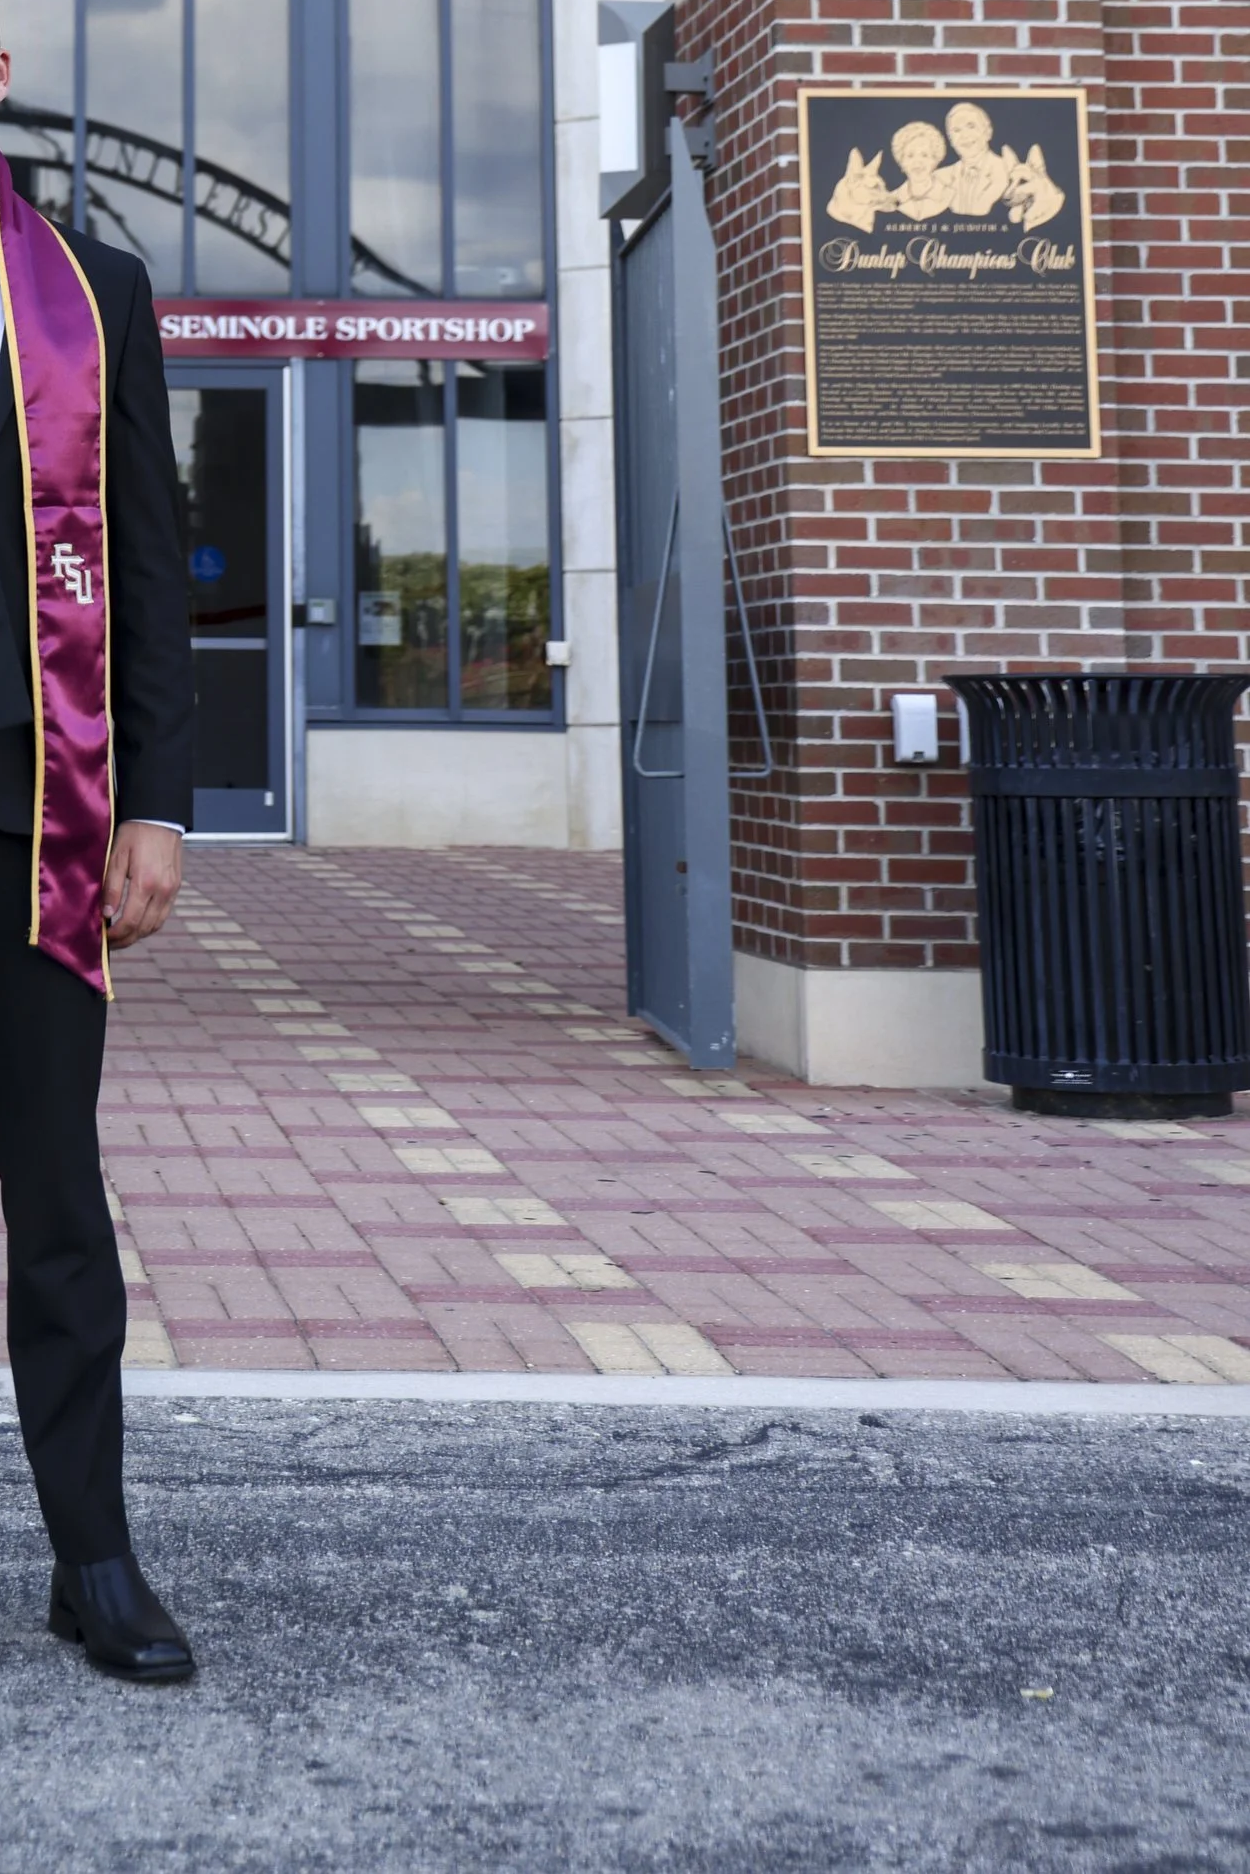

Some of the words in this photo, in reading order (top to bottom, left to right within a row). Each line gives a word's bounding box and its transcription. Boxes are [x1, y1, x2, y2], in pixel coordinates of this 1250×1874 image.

[818, 236, 907, 280] Dunlap
[905, 235, 1018, 280] Champions
[1016, 235, 1076, 278] Club
[159, 314, 329, 341] SEMINOLE
[334, 316, 536, 343] SPORTSHOP
[51, 542, 95, 604] FSU
